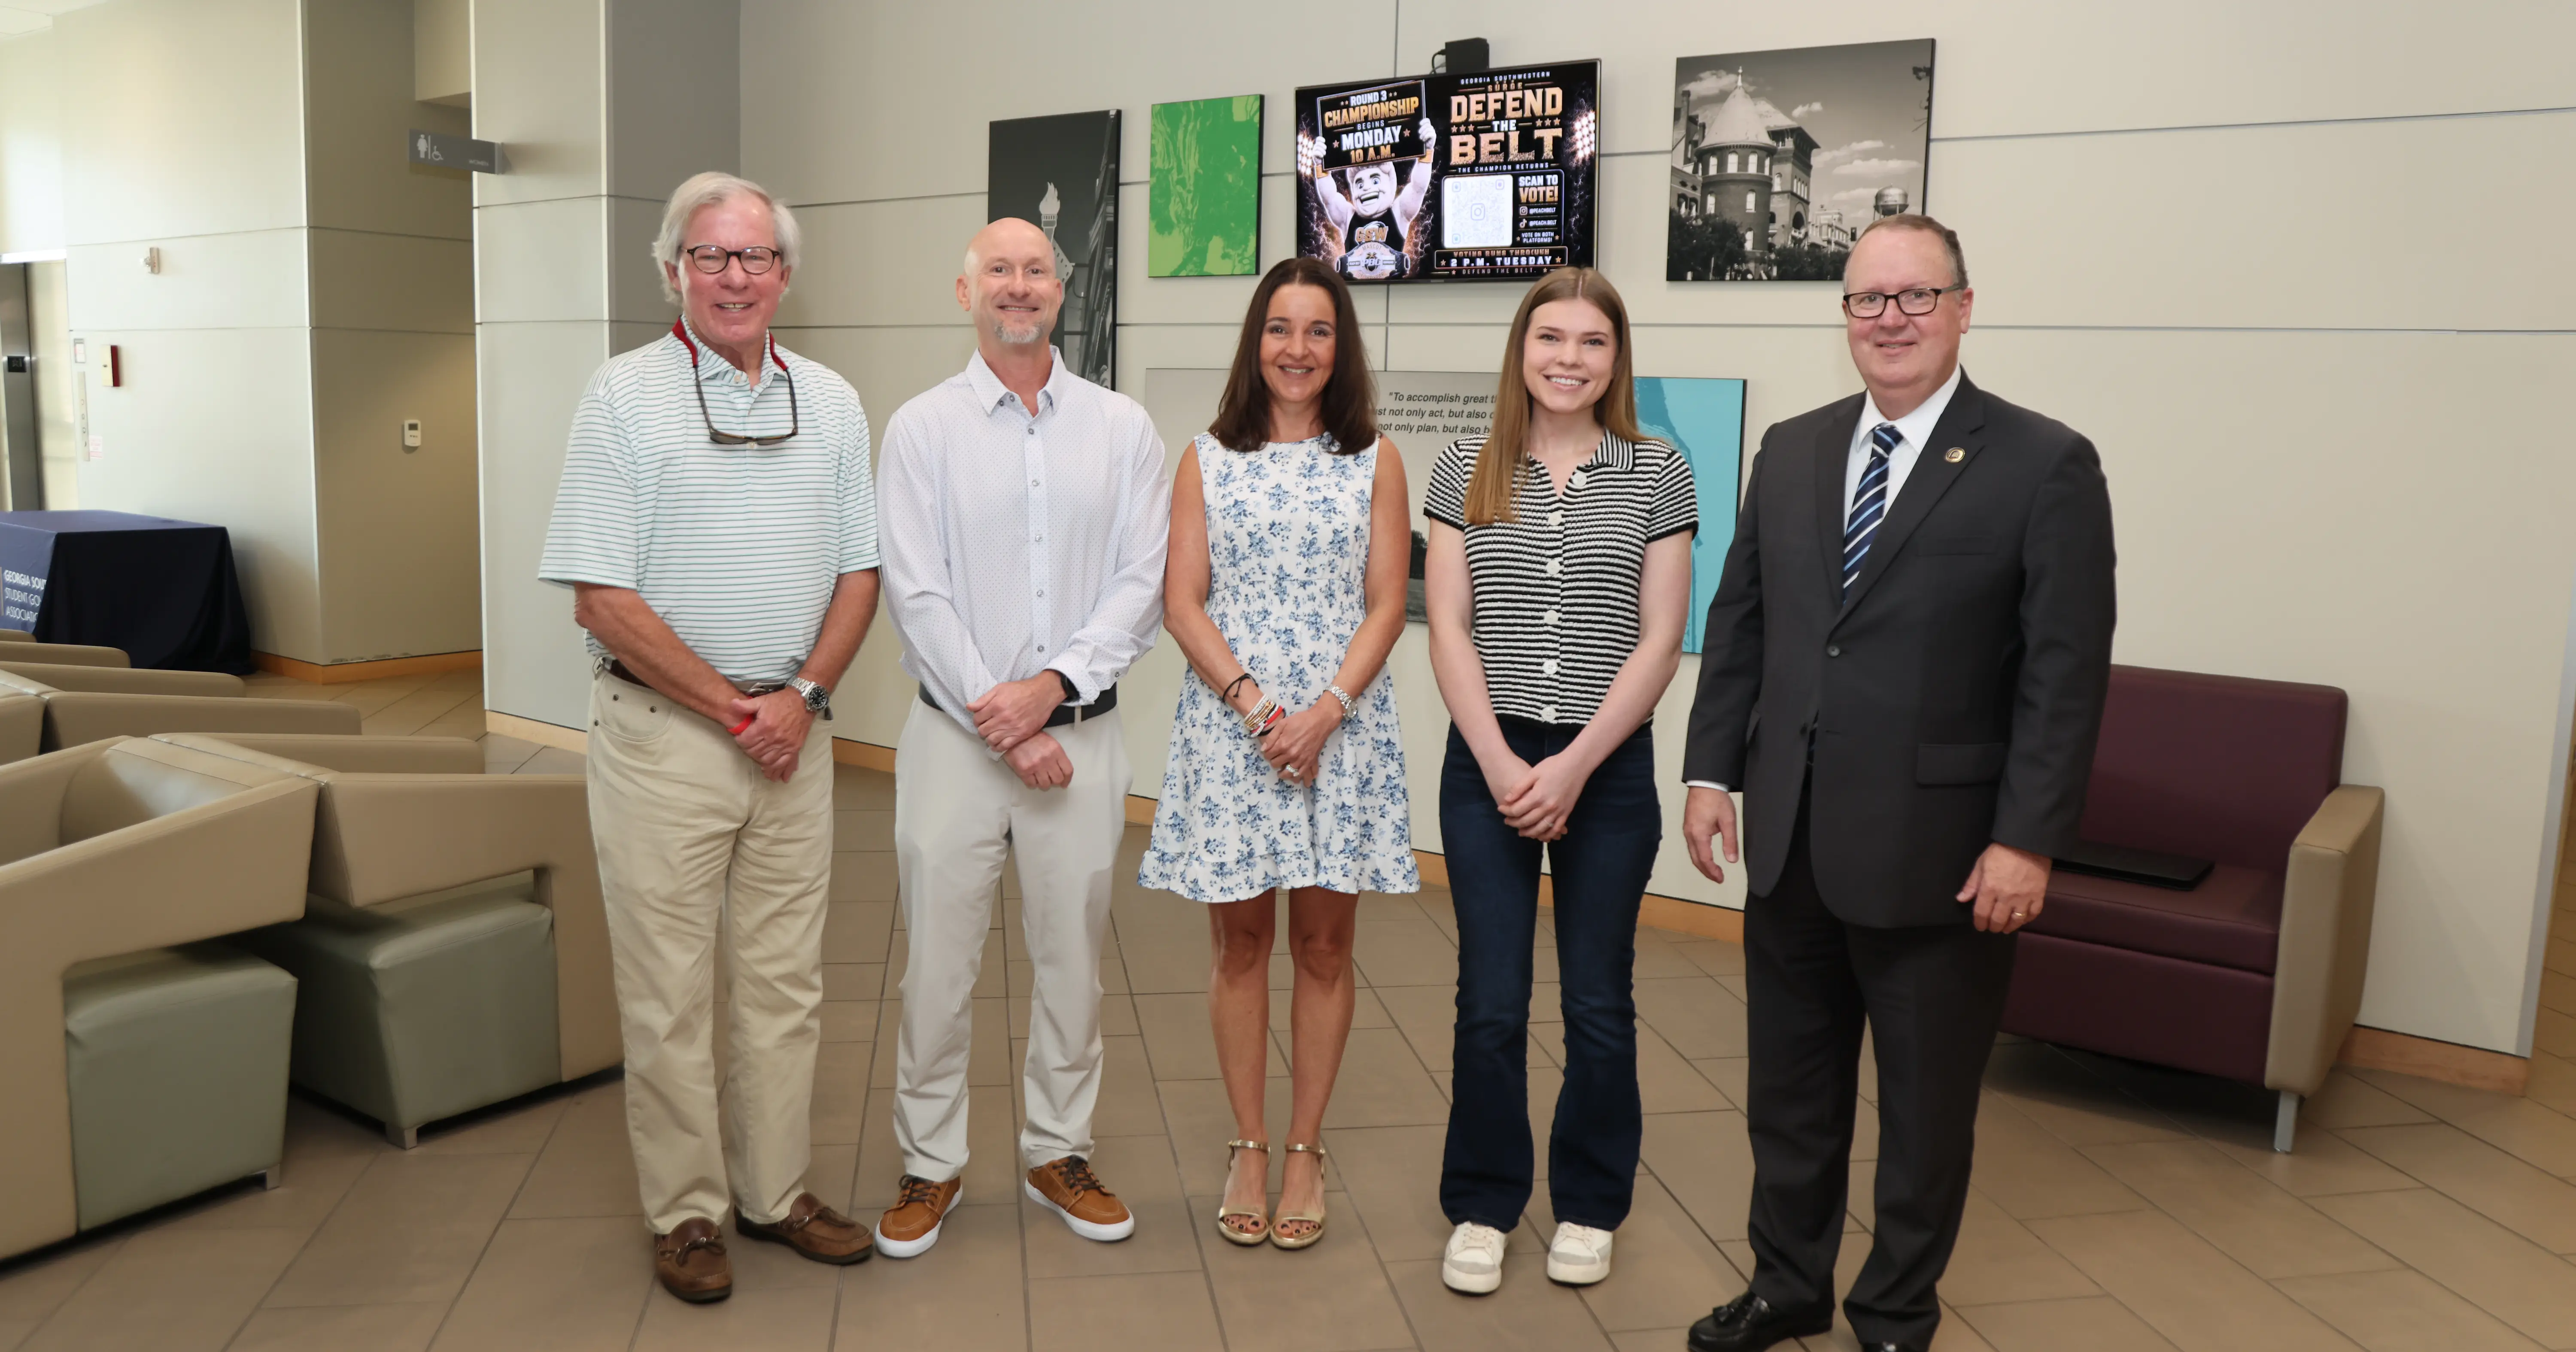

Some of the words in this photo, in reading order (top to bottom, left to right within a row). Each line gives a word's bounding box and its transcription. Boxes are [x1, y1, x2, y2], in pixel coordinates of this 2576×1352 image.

[1461, 76, 1490, 85] GEORGIA
[1494, 71, 1550, 82] SOUTHWESTERN
[1350, 91, 1379, 106] ROUND
[1381, 90, 1387, 101] 3
[1450, 87, 1562, 123] DEFEND
[1324, 97, 1419, 127] CHAMPIONSHIP
[1357, 120, 1385, 130] BEGINS
[1492, 119, 1516, 132] THE
[1341, 125, 1402, 151] MONDAY
[1350, 149, 1363, 163] 10
[1367, 145, 1395, 161] A.M.
[1450, 128, 1562, 165] BELT
[1519, 175, 1543, 187] SCAN
[1545, 174, 1558, 185] TO
[1519, 185, 1558, 203] VOTE!
[1356, 226, 1388, 242] GSW
[1451, 258, 1457, 267] 2
[1463, 258, 1490, 267] P.M.
[1496, 256, 1552, 266] TUESDAY
[1389, 392, 1404, 401] "To
[1406, 393, 1460, 404] accomplish
[1463, 394, 1488, 405] great
[1389, 408, 1403, 416] not
[1406, 408, 1426, 419] only
[1428, 409, 1445, 419] act,
[1448, 409, 1464, 418] but
[1467, 409, 1486, 419] also
[1377, 423, 1393, 431] not
[1394, 423, 1415, 433] only
[1417, 423, 1439, 434] plan,
[1443, 424, 1458, 433] but
[1461, 425, 1480, 434] also
[4, 569, 31, 586] GEORGIA
[5, 587, 28, 603] STUDENT
